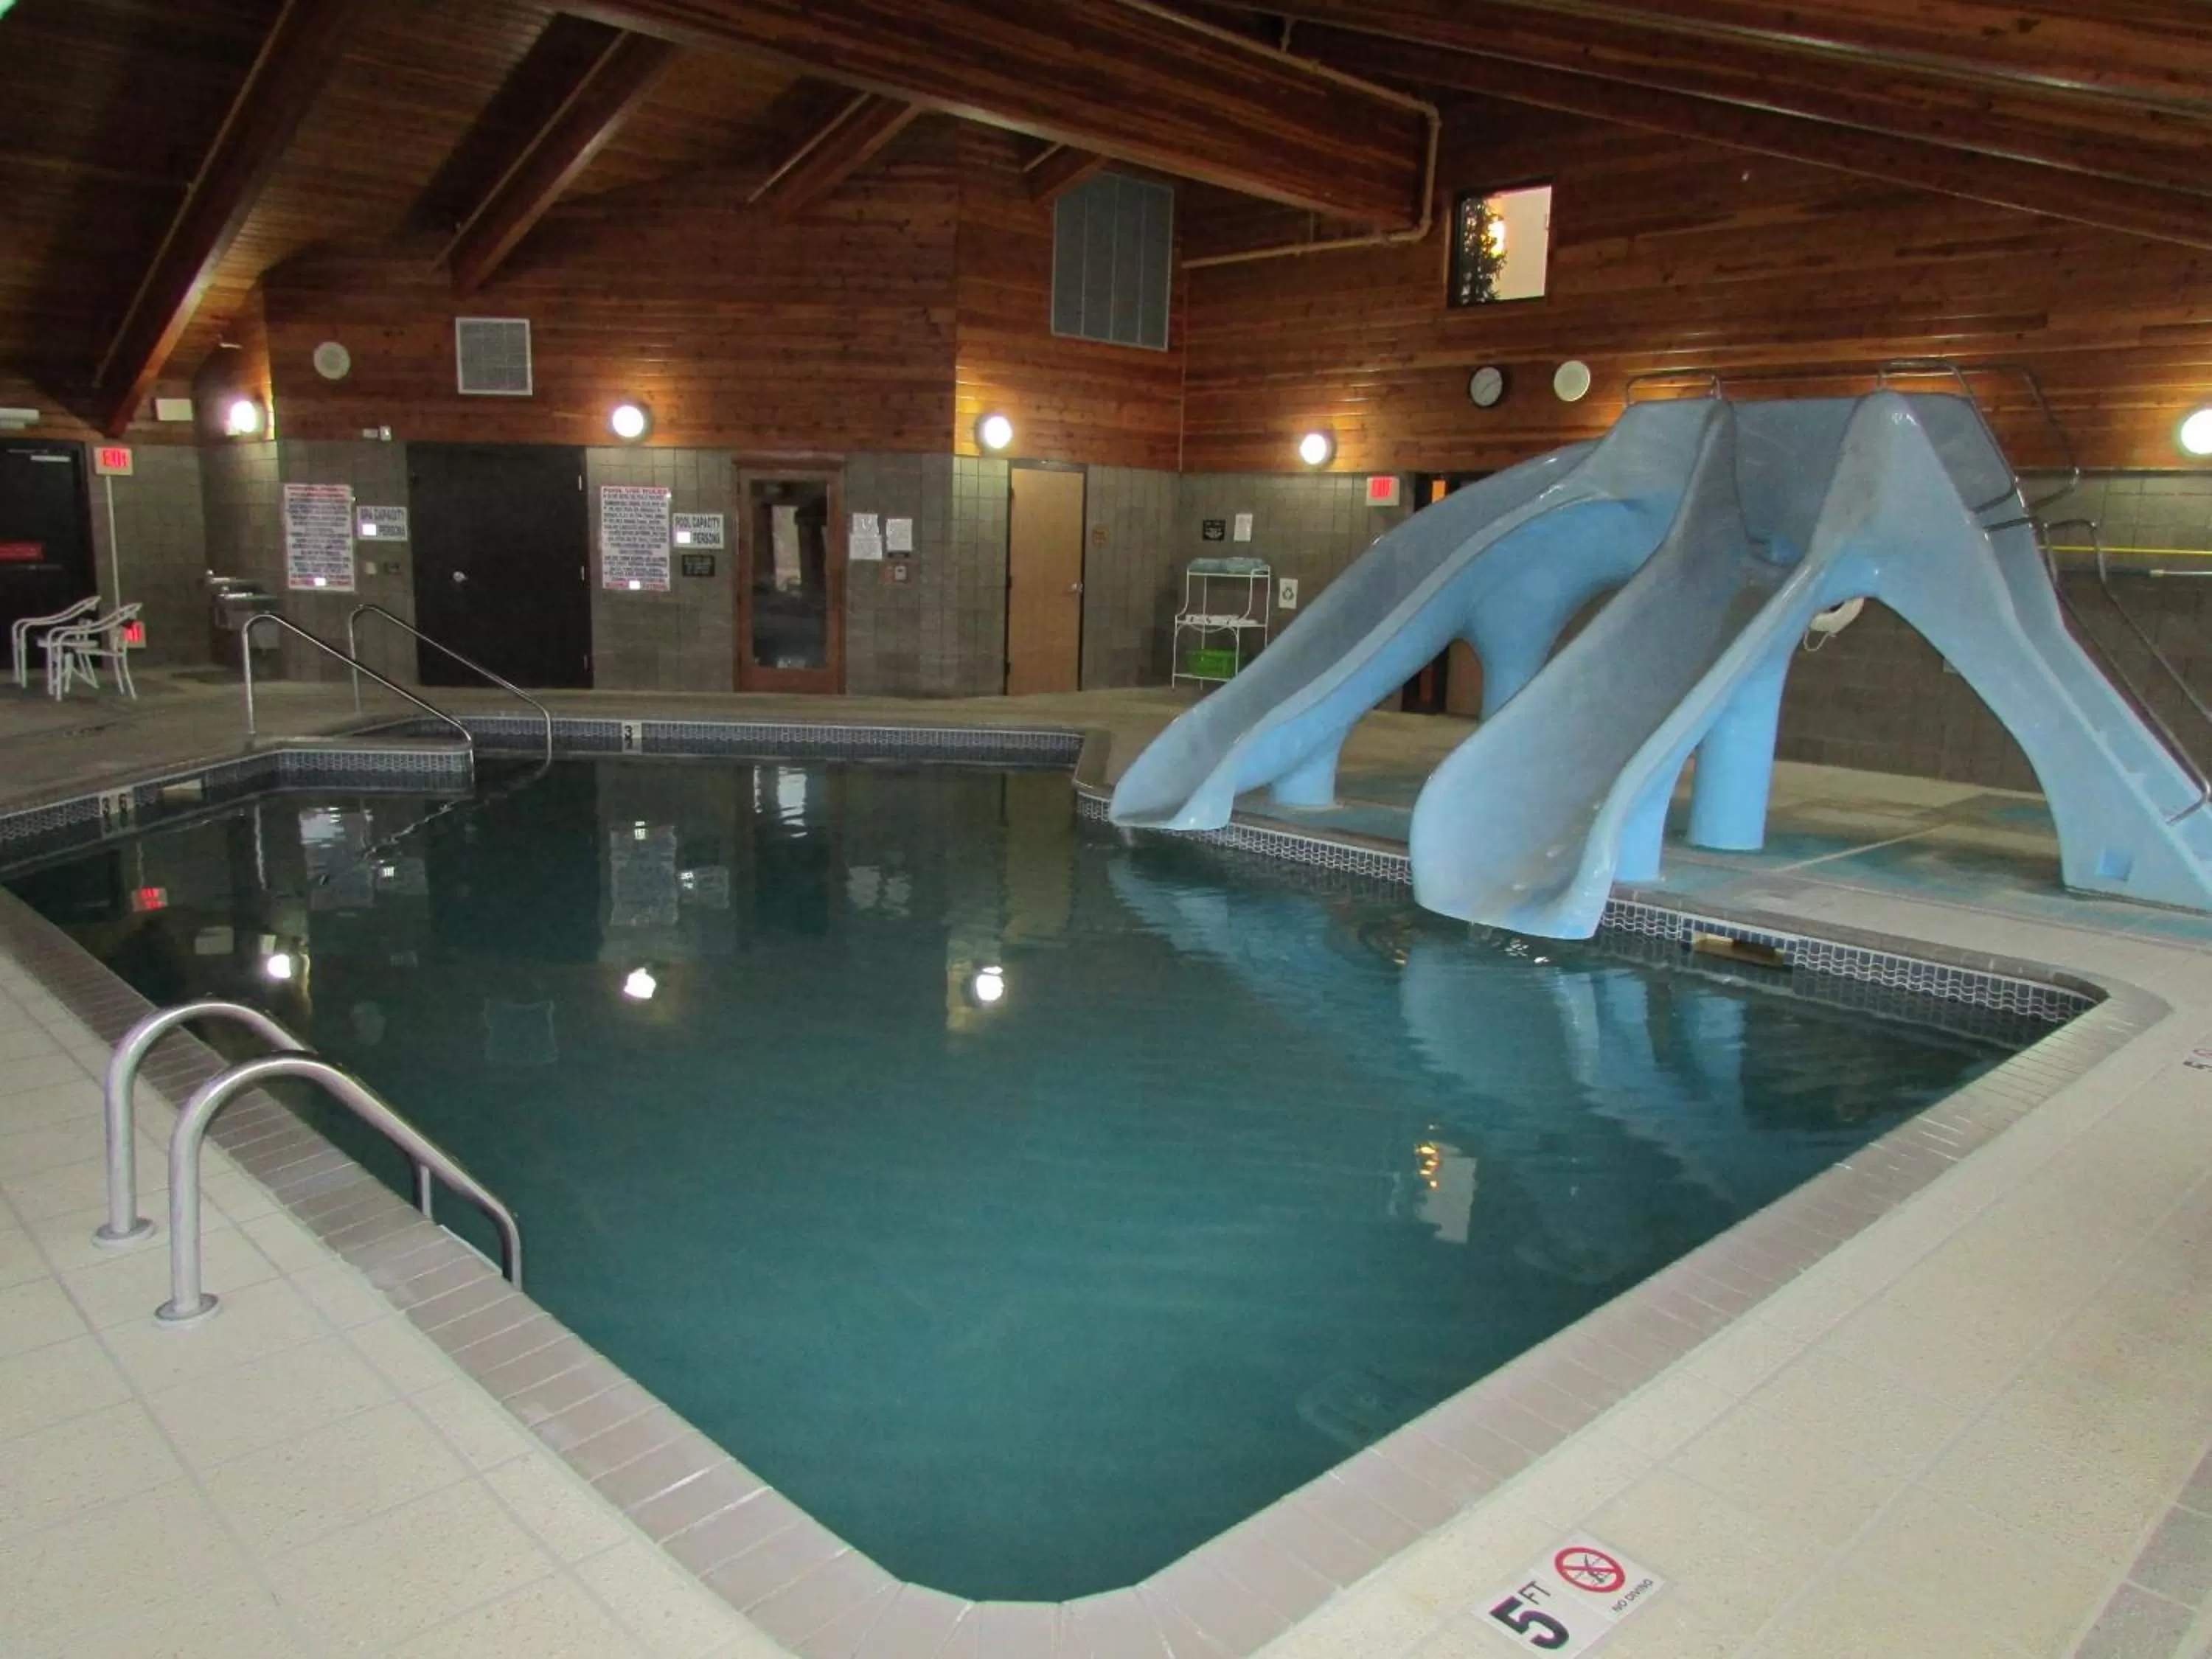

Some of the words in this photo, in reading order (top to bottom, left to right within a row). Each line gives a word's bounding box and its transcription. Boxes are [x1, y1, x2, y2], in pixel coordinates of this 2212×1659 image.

[102, 449, 127, 467] EXIT
[374, 509, 405, 521] CAPACITY
[675, 516, 691, 528] POOL
[692, 516, 720, 529] CAPACITY
[1517, 1580, 1551, 1605] FT
[1611, 1599, 1628, 1612] NO
[1624, 1578, 1654, 1601] DIVING
[1489, 1595, 1570, 1650] 5
